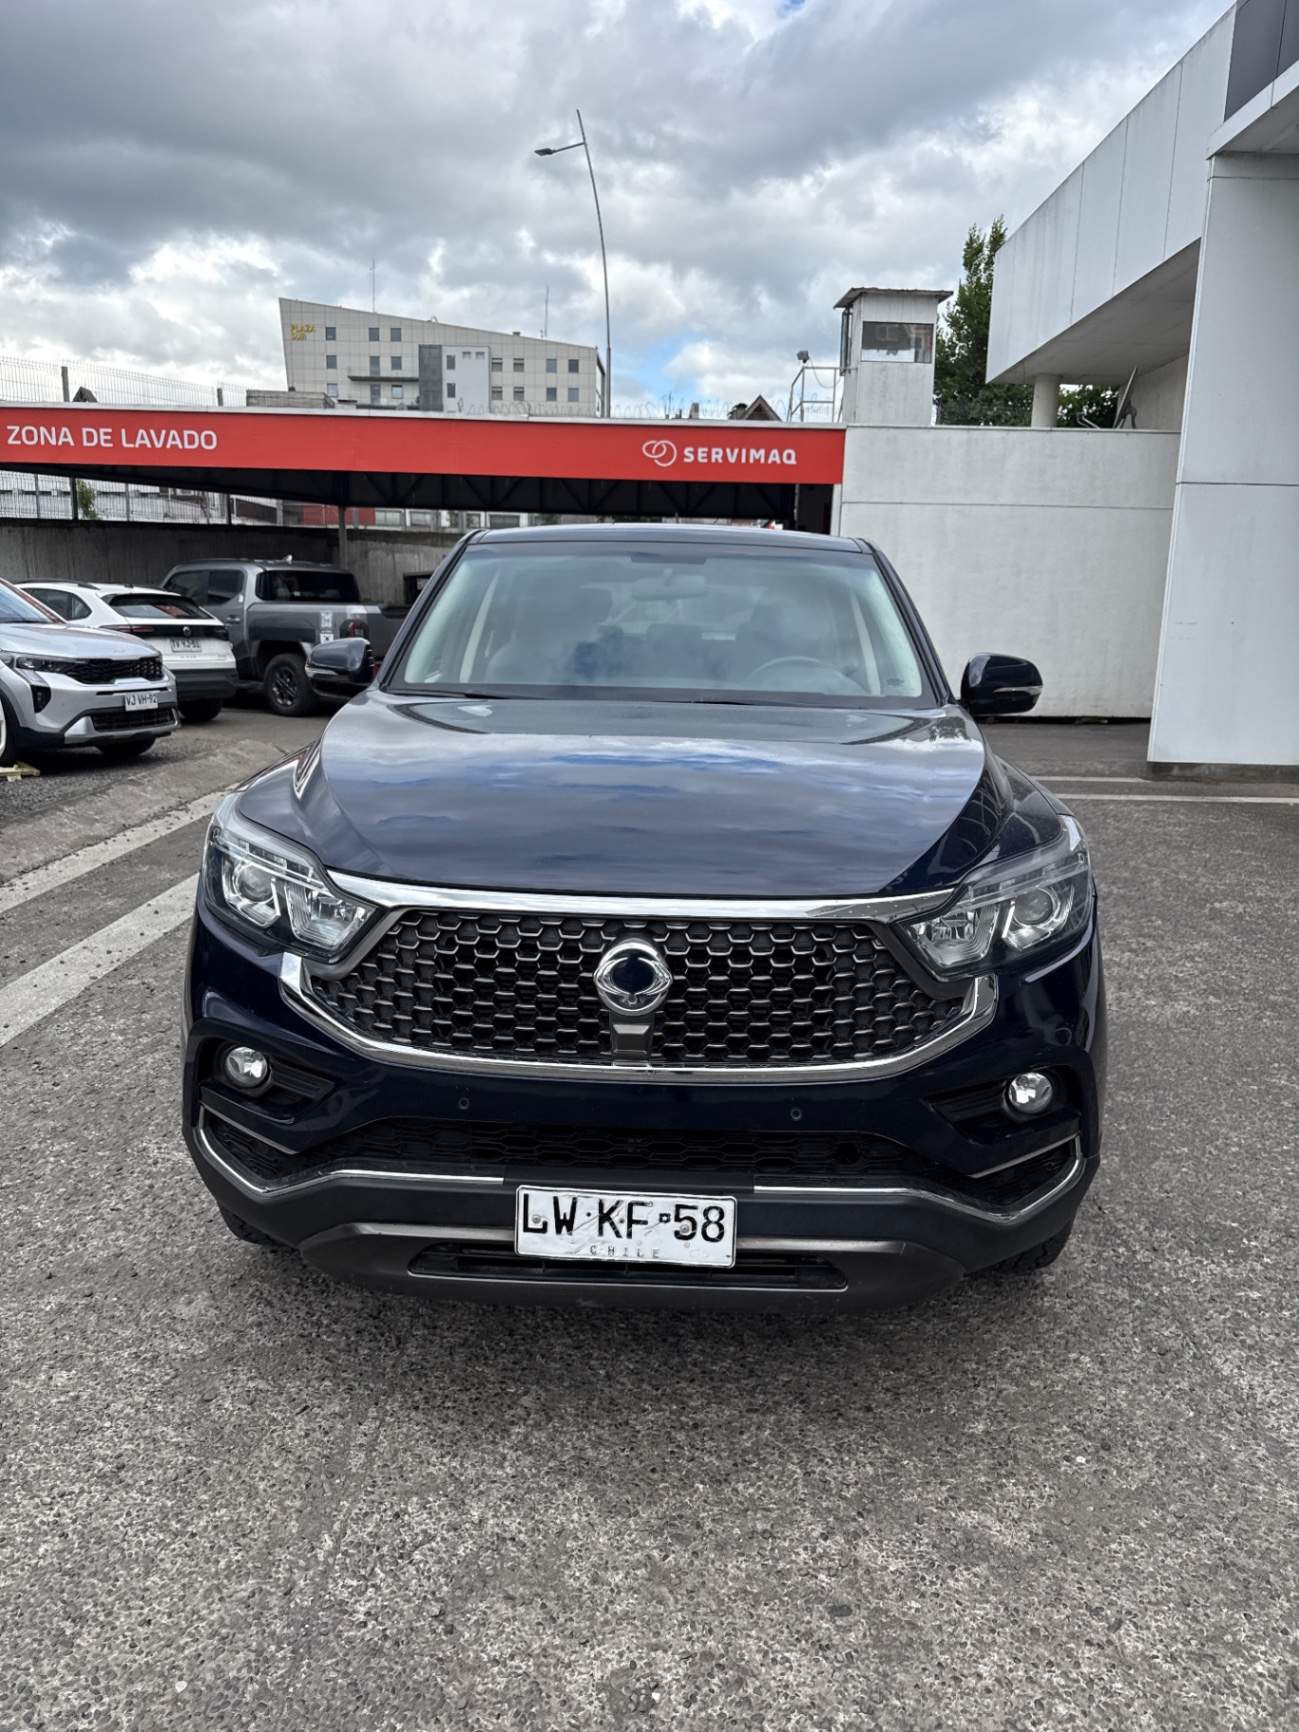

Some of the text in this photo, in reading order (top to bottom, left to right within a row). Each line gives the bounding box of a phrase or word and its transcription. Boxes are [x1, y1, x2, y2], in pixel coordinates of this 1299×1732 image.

[6, 425, 218, 450] ZONA DE LAVADO
[683, 446, 798, 465] SERVIMAQ
[589, 1244, 660, 1259] CHILE
